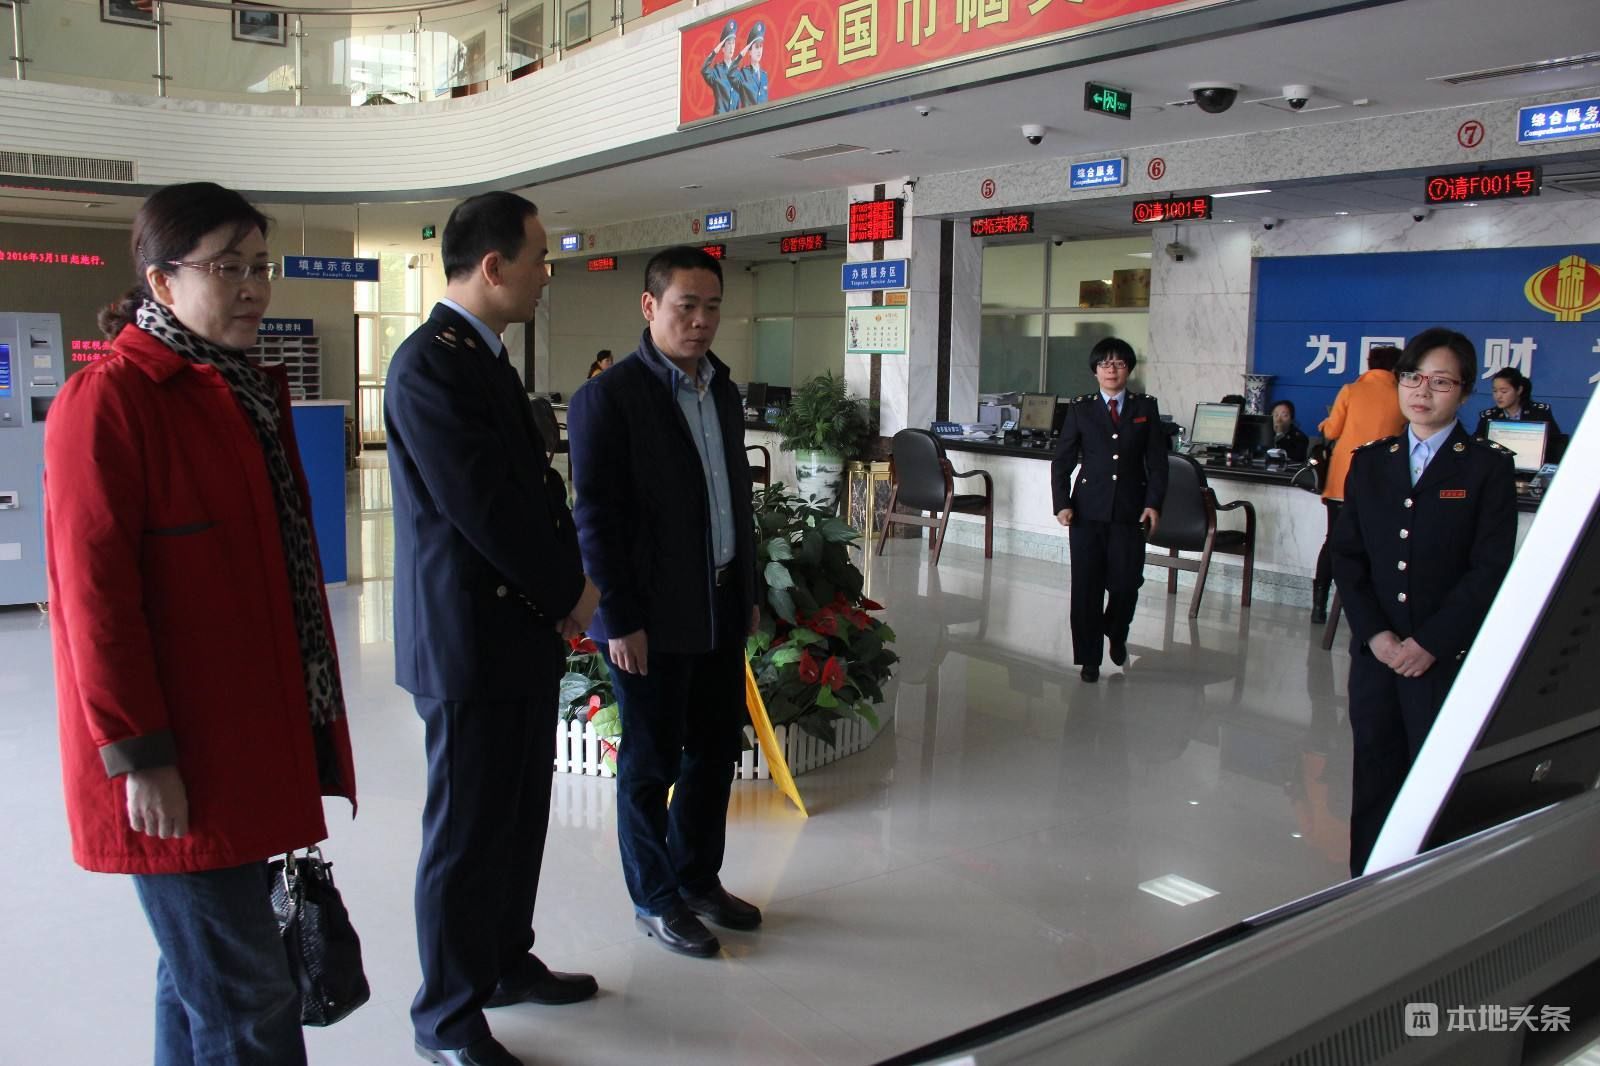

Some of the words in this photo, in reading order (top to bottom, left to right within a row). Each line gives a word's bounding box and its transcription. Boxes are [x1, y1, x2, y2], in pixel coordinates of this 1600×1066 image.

[1531, 105, 1599, 127] 综合服务
[299, 260, 364, 272] 填单示范区
[852, 266, 896, 280] 办税服务区
